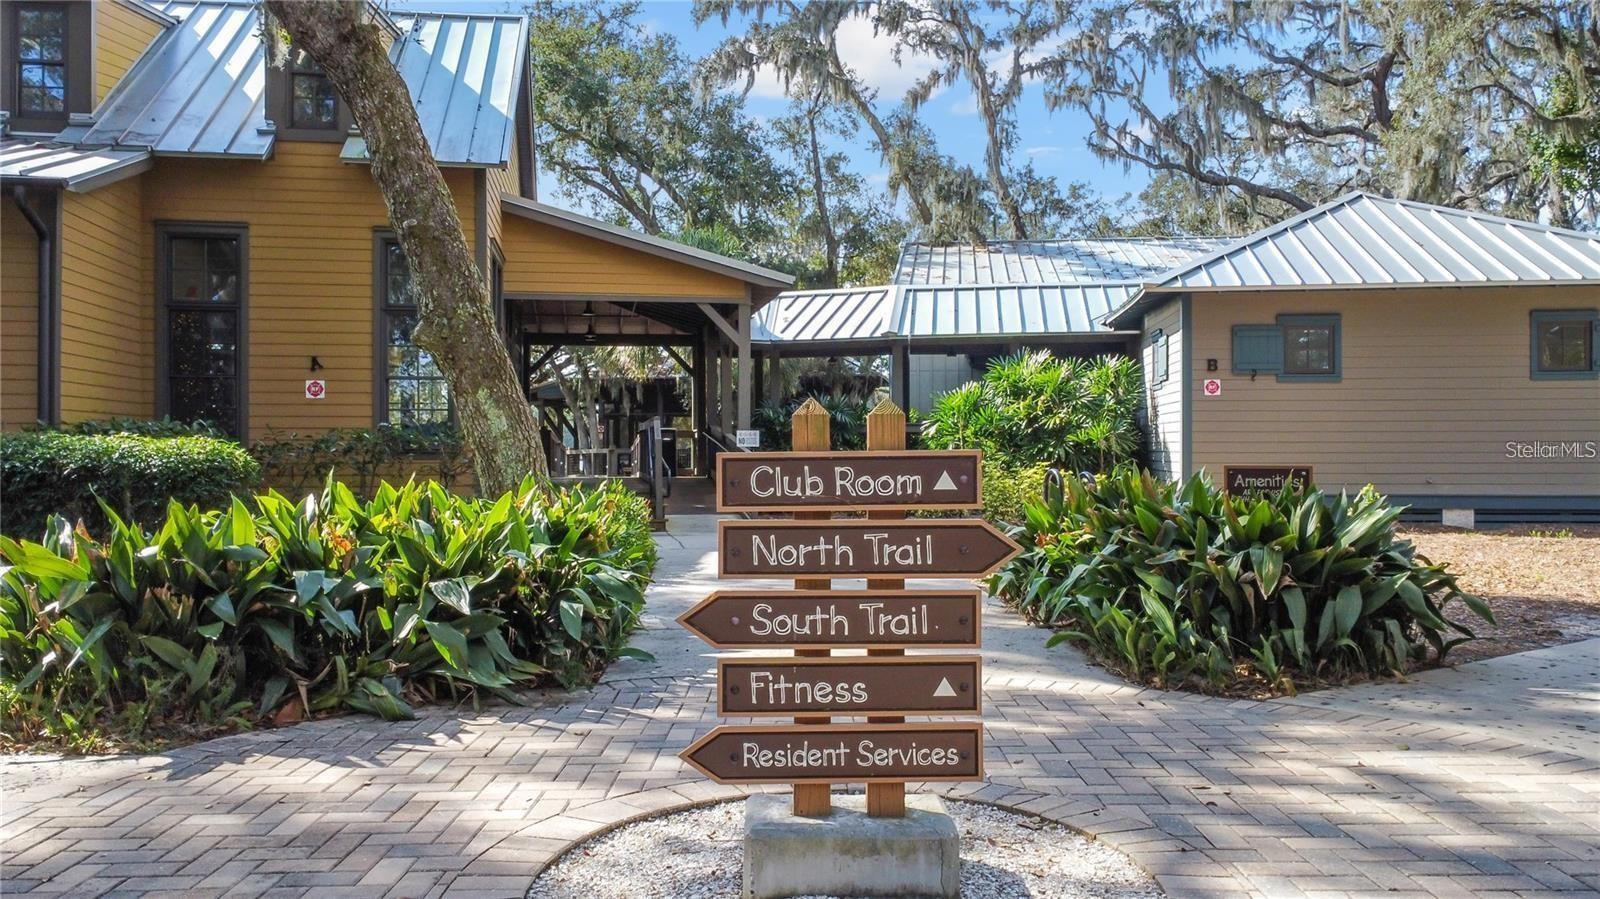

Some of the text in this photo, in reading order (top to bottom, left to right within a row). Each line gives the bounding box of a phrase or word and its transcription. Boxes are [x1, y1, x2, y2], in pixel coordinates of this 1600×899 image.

[1206, 358, 1218, 372] B
[750, 465, 922, 498] Club Room
[1234, 474, 1300, 488] Amenitis
[752, 533, 933, 566] North Trail
[749, 602, 928, 636] South Trail
[750, 671, 869, 704] Fitness
[742, 740, 960, 768] Resident Services
